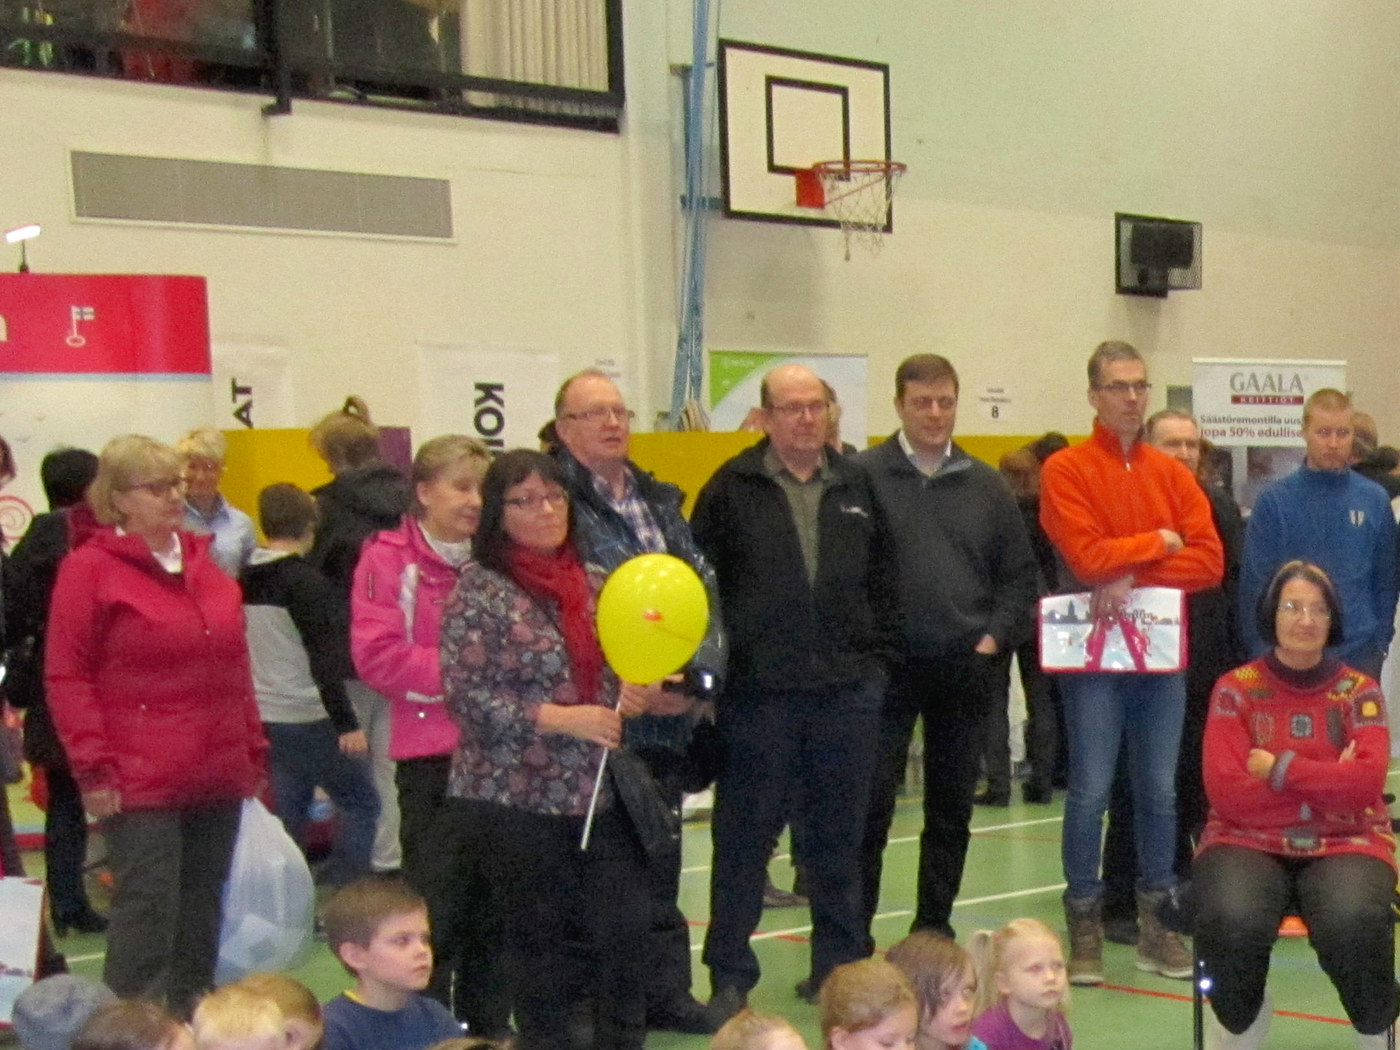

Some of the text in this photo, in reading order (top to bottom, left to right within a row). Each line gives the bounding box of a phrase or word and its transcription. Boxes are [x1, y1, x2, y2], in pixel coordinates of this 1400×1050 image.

[1230, 372, 1304, 393] GAALA
[991, 405, 999, 419] 8
[1200, 414, 1282, 425] Säästöremontilla
[1200, 427, 1227, 439] jopa
[1229, 427, 1256, 438] 50%
